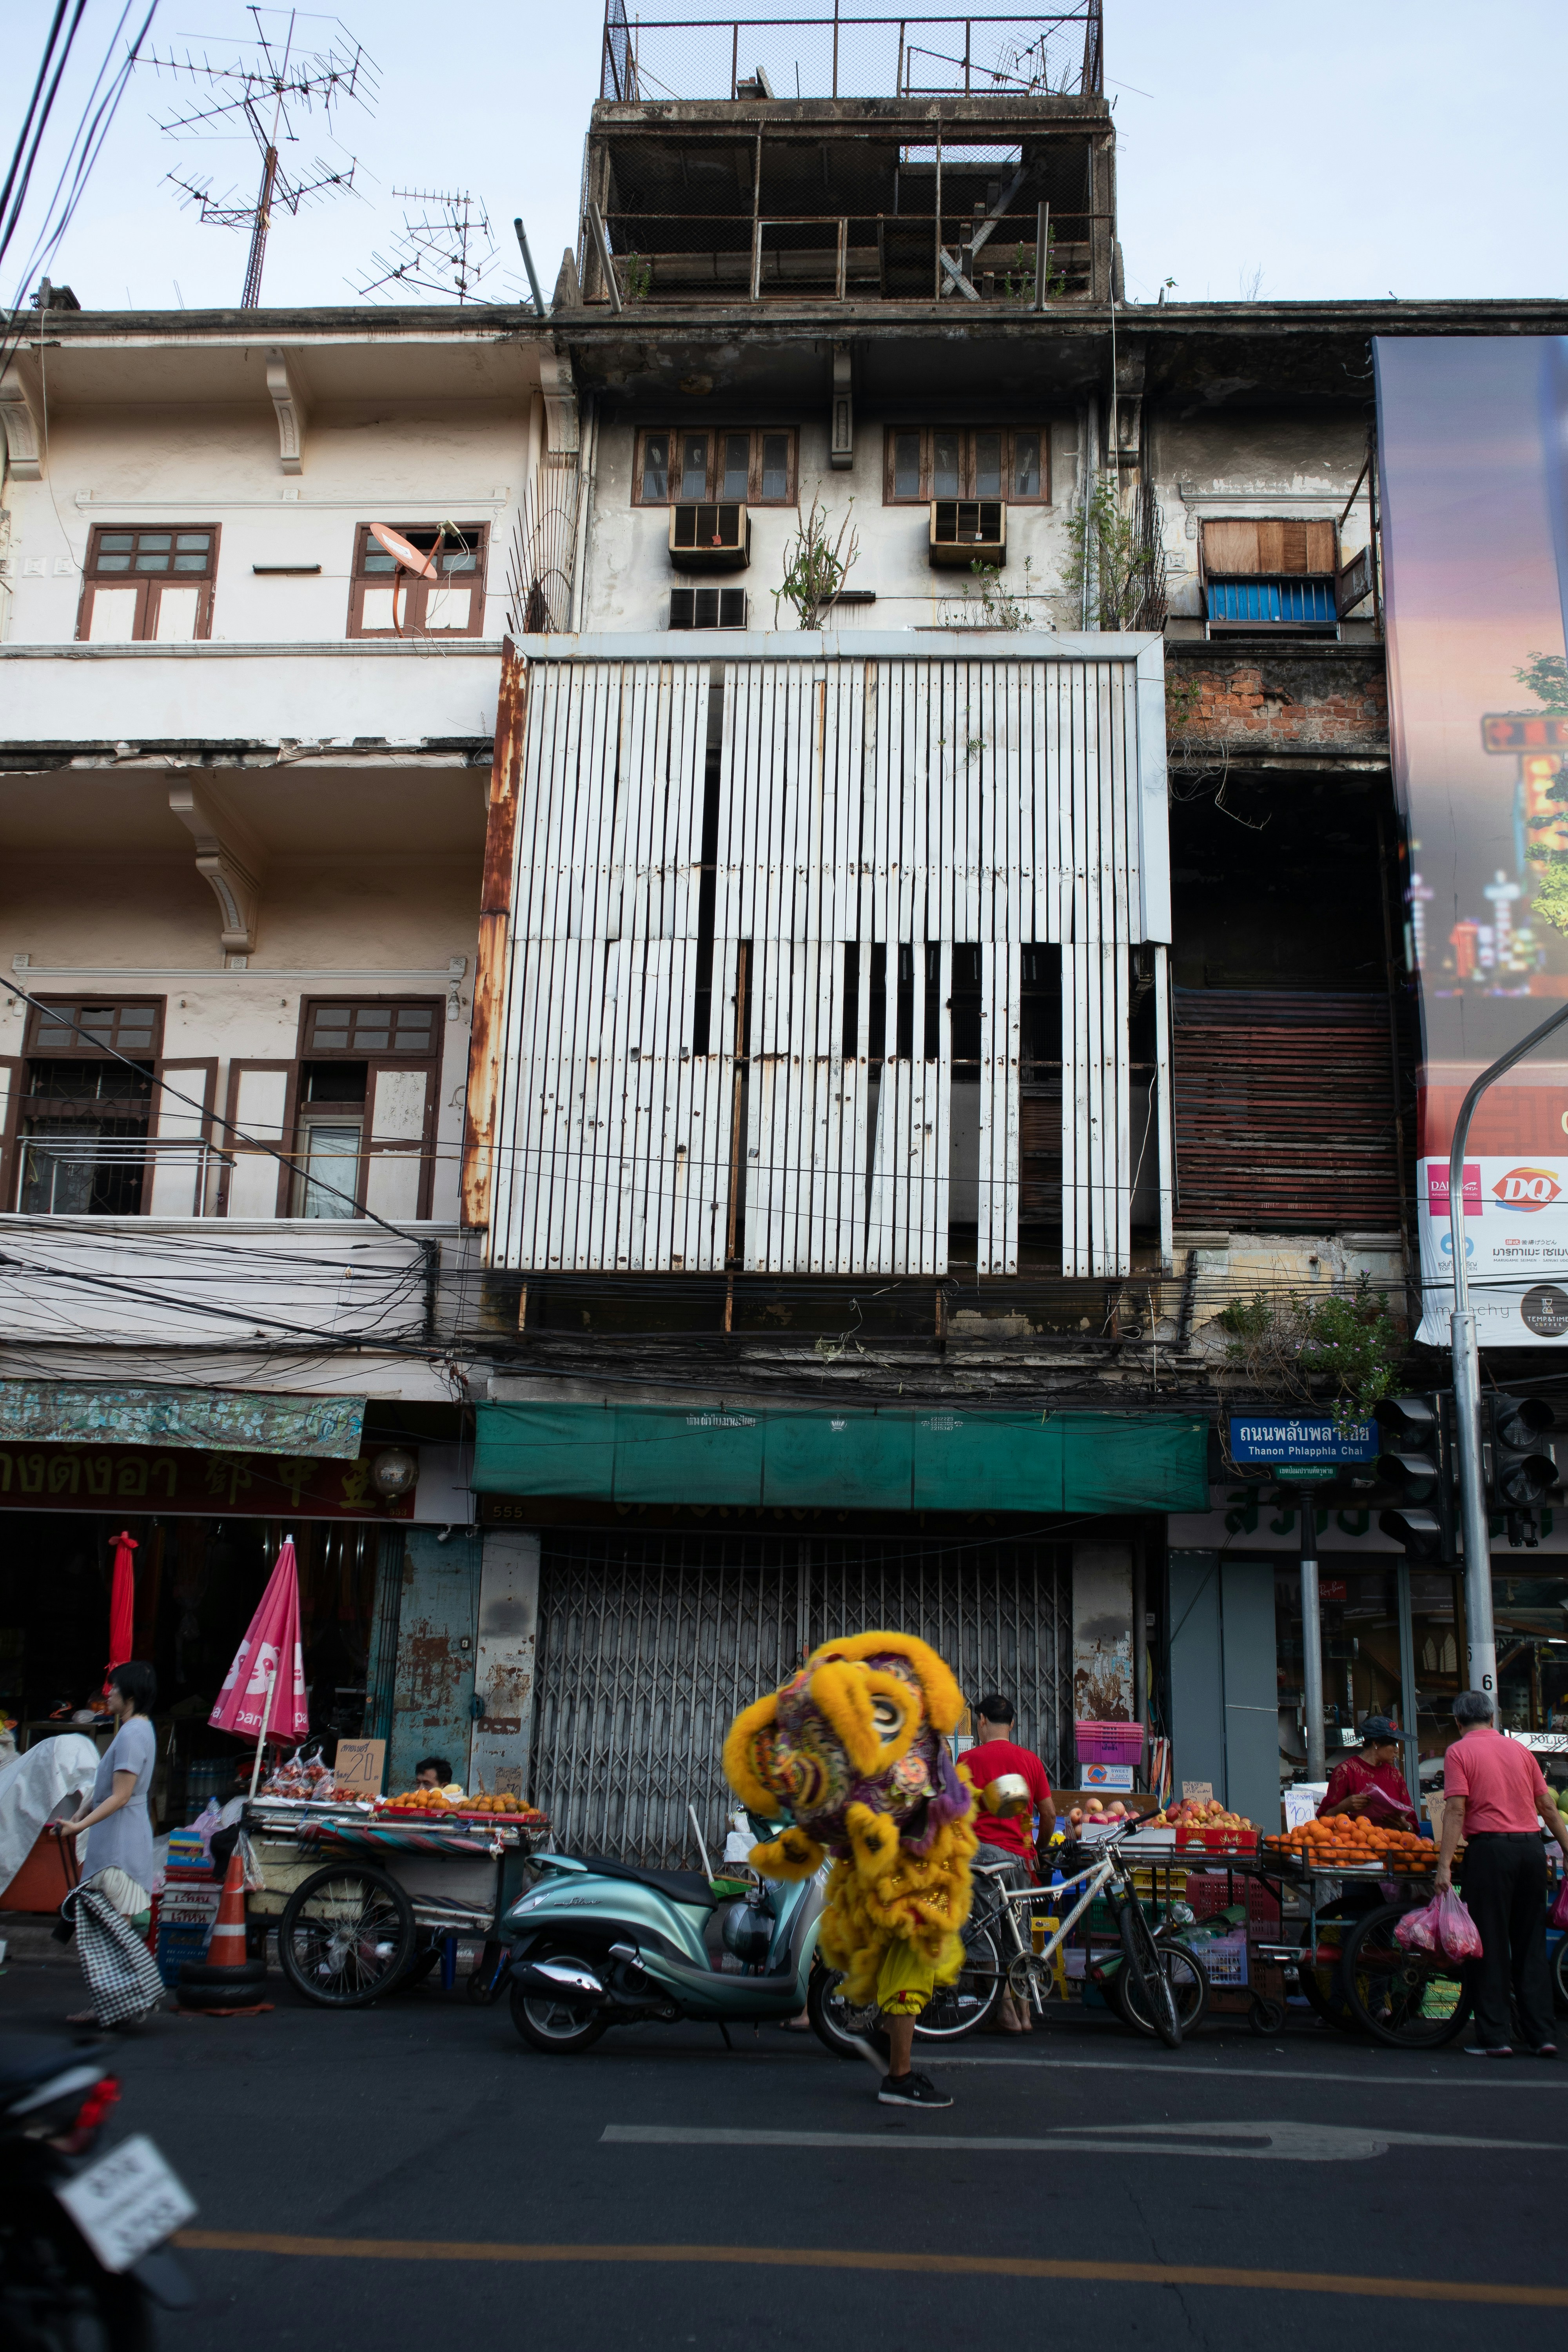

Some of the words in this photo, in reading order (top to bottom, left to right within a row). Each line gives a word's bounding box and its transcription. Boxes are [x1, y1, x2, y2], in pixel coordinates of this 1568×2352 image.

[1431, 1181, 1463, 1189] DAI
[1503, 1177, 1551, 1202] DQ
[1436, 1303, 1509, 1318] mnchy
[1249, 1446, 1284, 1455] Thanon
[1289, 1446, 1336, 1457] Phlapphla
[1341, 1446, 1363, 1455] Chai
[1279, 1465, 1333, 1476] เขตป้อมปราบศัตรูพ่าย
[389, 1508, 407, 1517] 553
[493, 1506, 523, 1518] 555
[1482, 1674, 1492, 1691] 6
